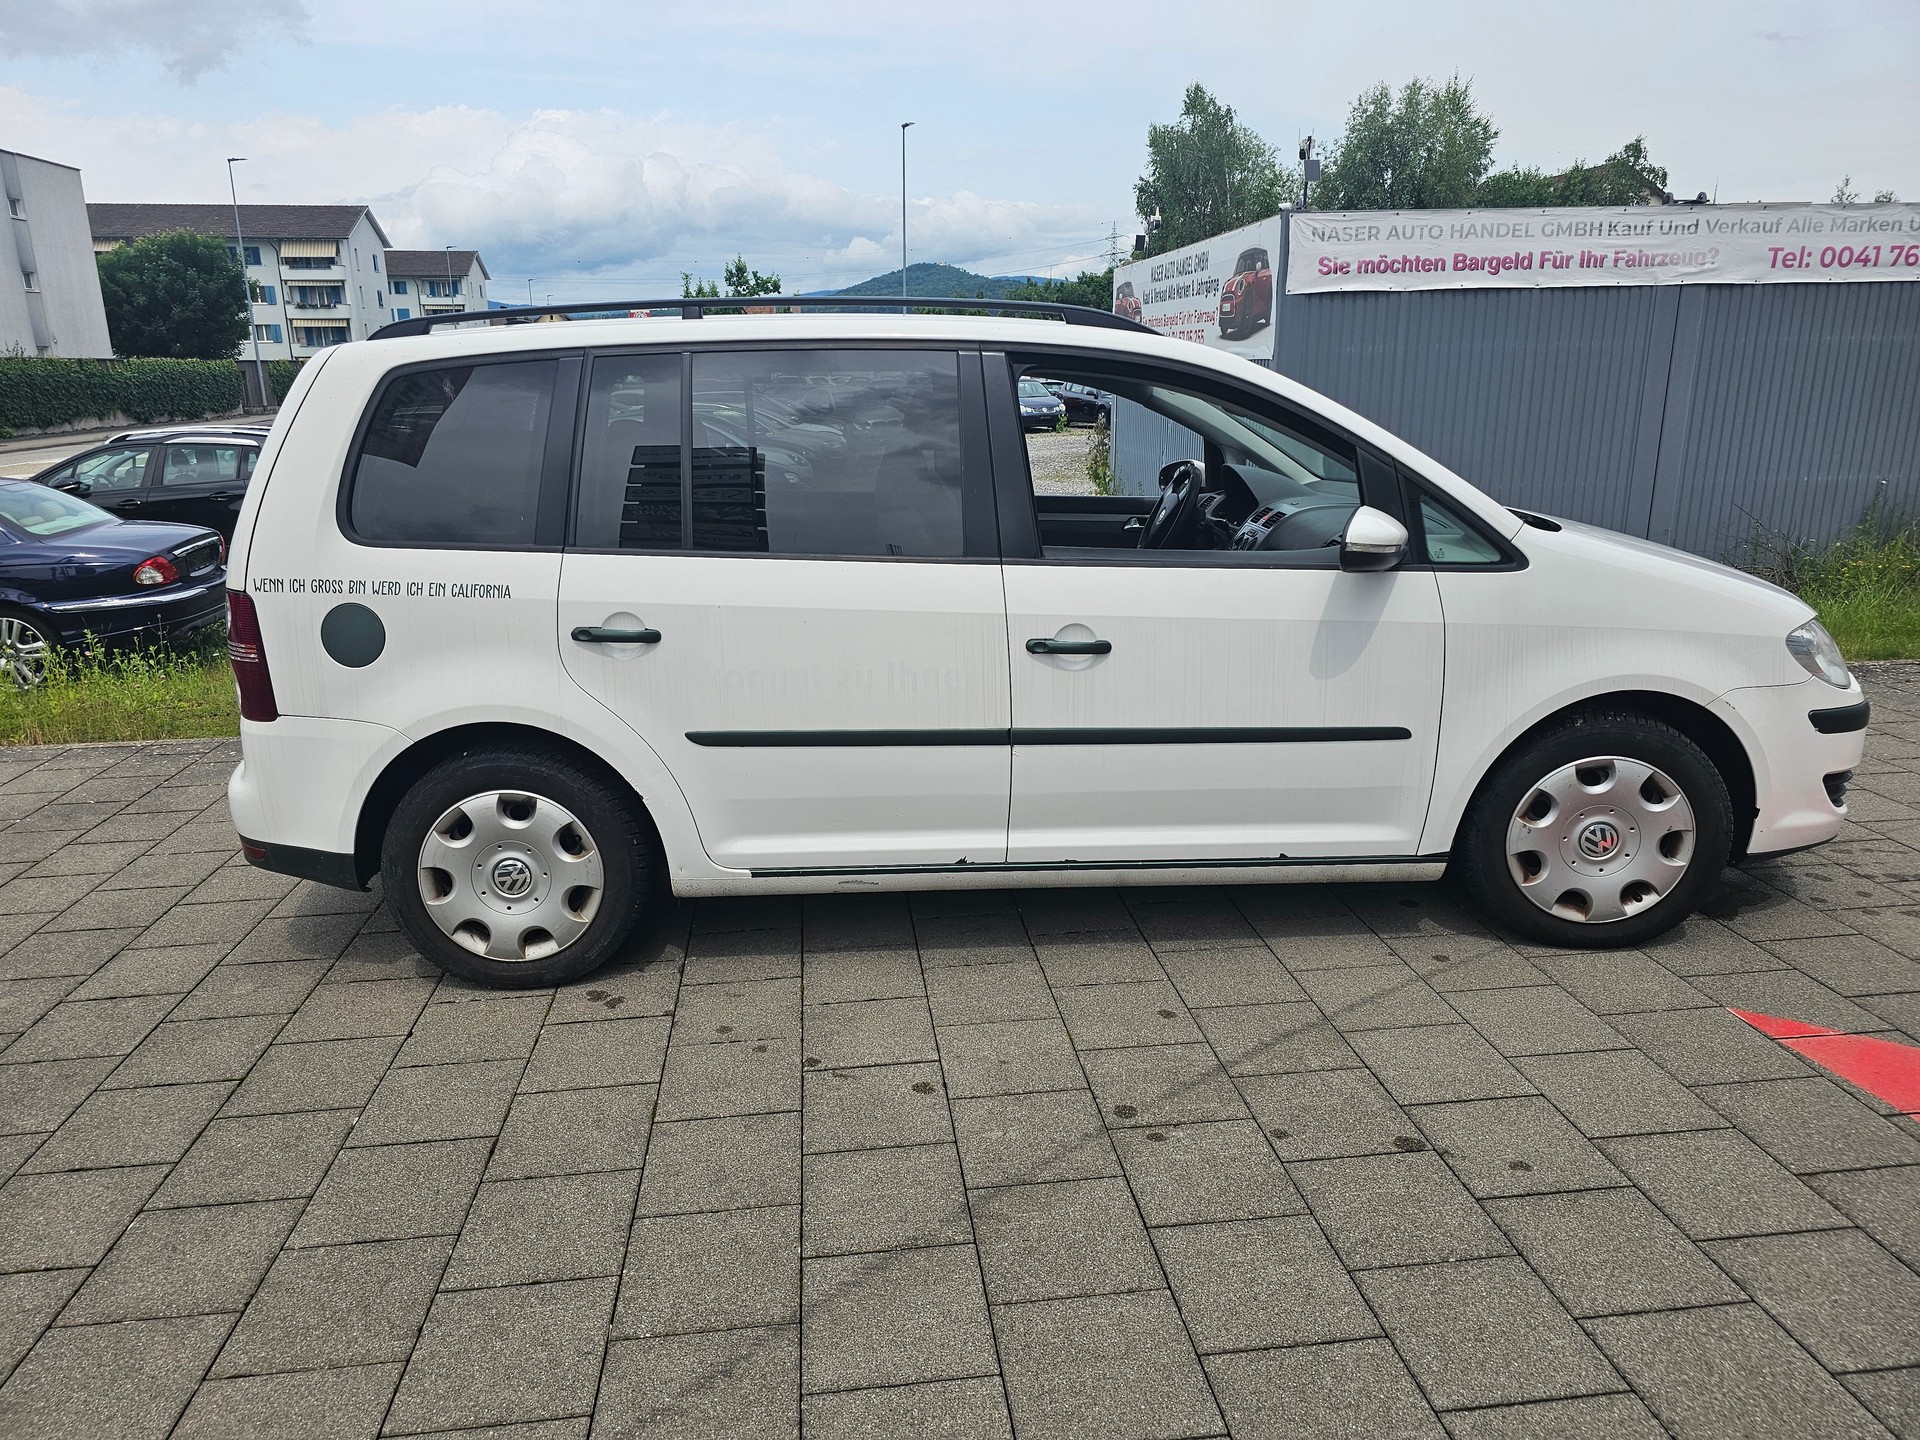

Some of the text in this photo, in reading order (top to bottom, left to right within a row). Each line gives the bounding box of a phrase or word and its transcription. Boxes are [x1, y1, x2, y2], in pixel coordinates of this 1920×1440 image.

[1311, 225, 1381, 242] NASER
[1386, 224, 1444, 241] AUTO
[1450, 222, 1535, 239] HANDEL
[1541, 221, 1603, 238] GMBH
[1608, 220, 1654, 237] Kauf
[1659, 219, 1699, 235] Und
[1706, 217, 1784, 234] Verkauf
[1786, 216, 1824, 233] Alle
[1830, 216, 1902, 233] Marken
[1164, 261, 1176, 280] AUTO
[1176, 255, 1194, 278] HANDEL
[1194, 250, 1209, 273] GMBH
[1317, 246, 1720, 276] Sie möchten Bargeld Für Ihr Fahrzeug?
[1768, 244, 1920, 269] Tel: 0041 76
[1176, 281, 1191, 300] Marken
[253, 577, 512, 599] WENN ICH GROSS BIN WERD ICH EIN CALIFORNIA
